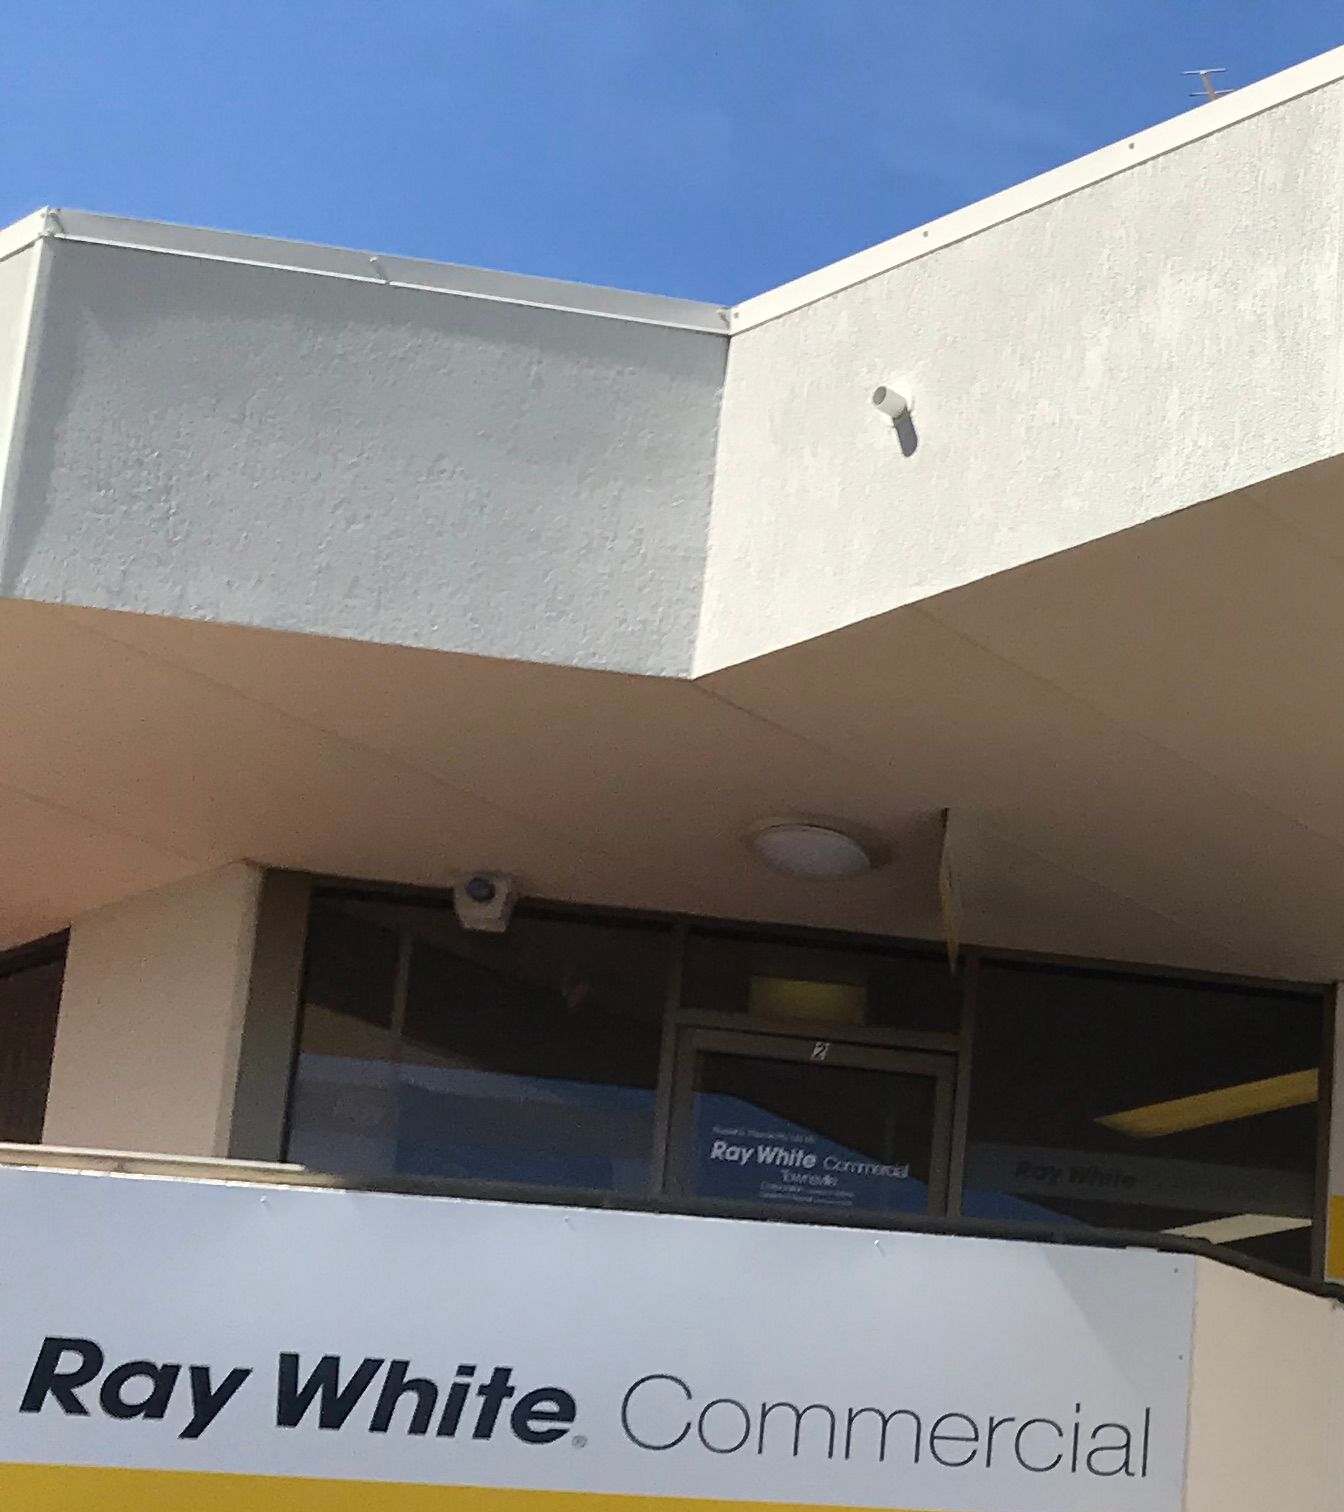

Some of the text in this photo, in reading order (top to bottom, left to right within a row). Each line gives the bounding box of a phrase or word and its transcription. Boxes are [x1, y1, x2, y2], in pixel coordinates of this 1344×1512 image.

[710, 1140, 753, 1166] Ray
[757, 1146, 817, 1169] White
[18, 1336, 1151, 1478] Ray White Commercial
